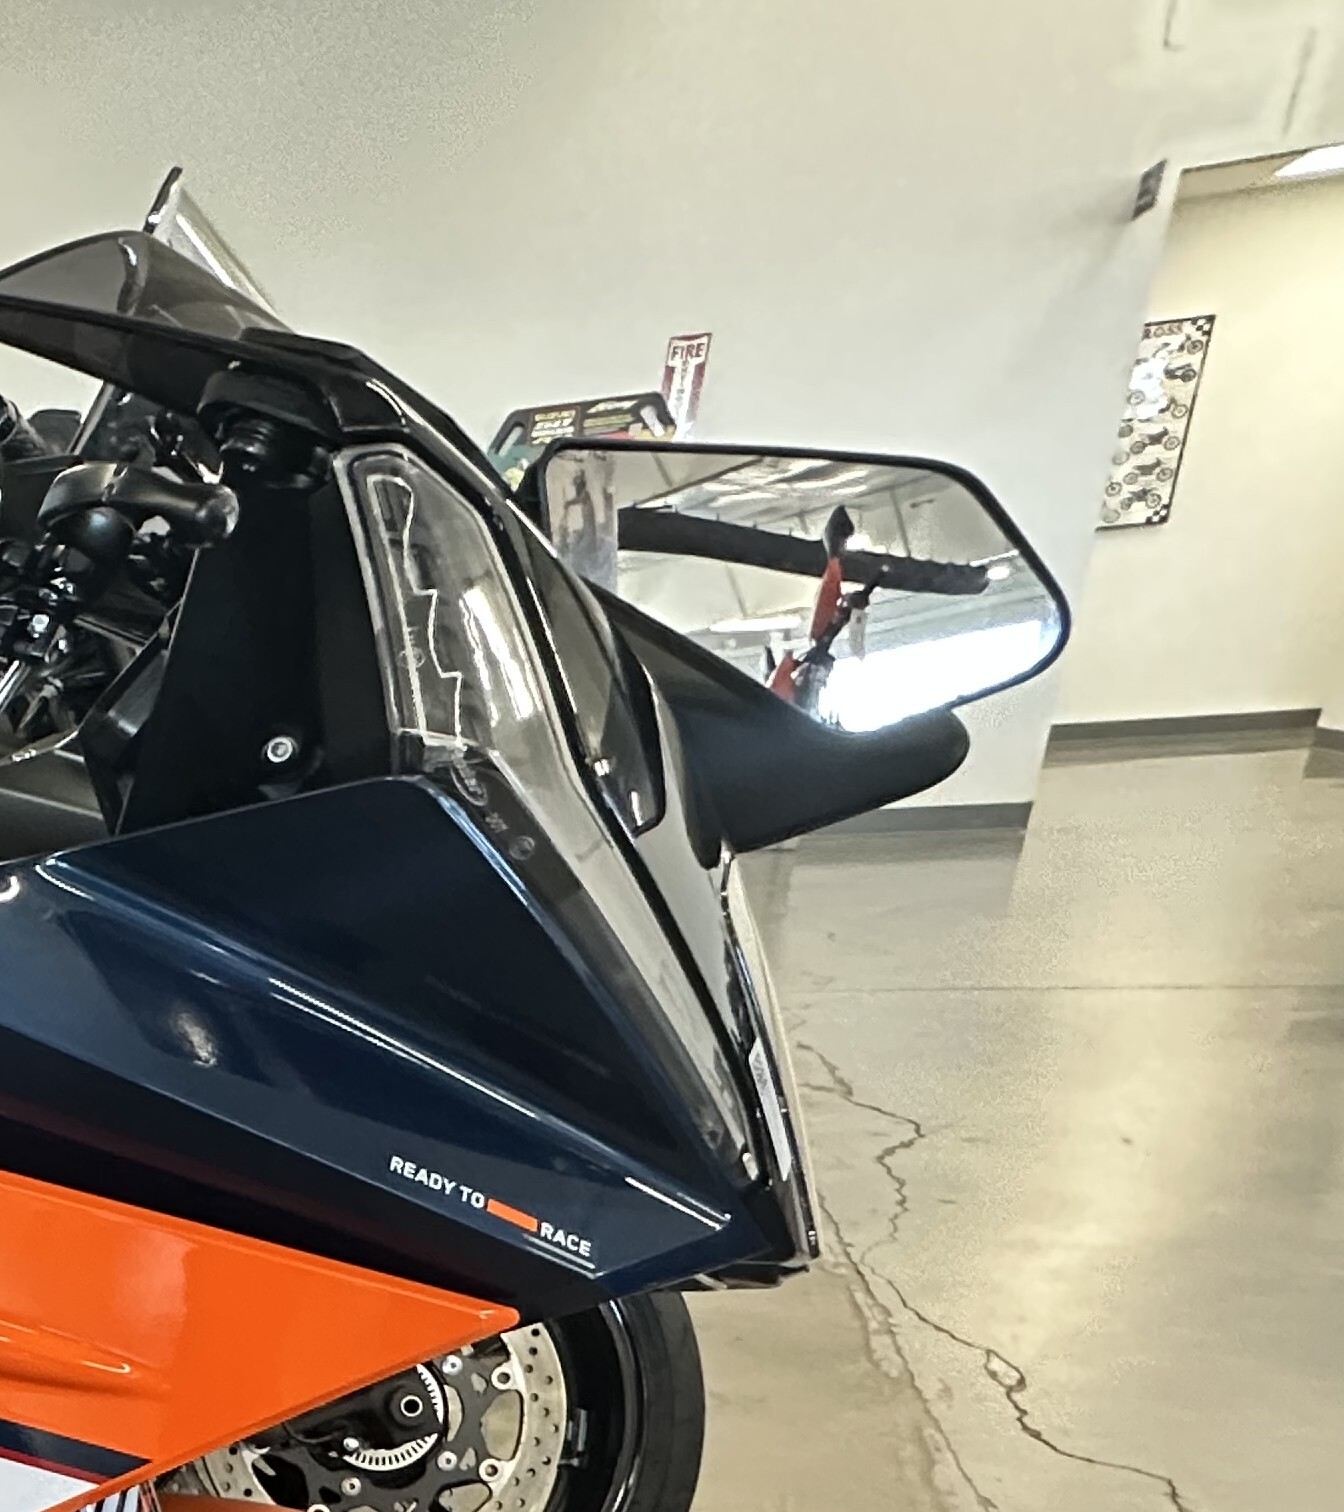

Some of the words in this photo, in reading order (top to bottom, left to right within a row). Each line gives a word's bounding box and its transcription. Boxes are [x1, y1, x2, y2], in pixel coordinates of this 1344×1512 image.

[672, 342, 706, 361] FIRE
[389, 1155, 456, 1196] READY
[459, 1184, 486, 1209] TO
[539, 1220, 592, 1257] RACE
